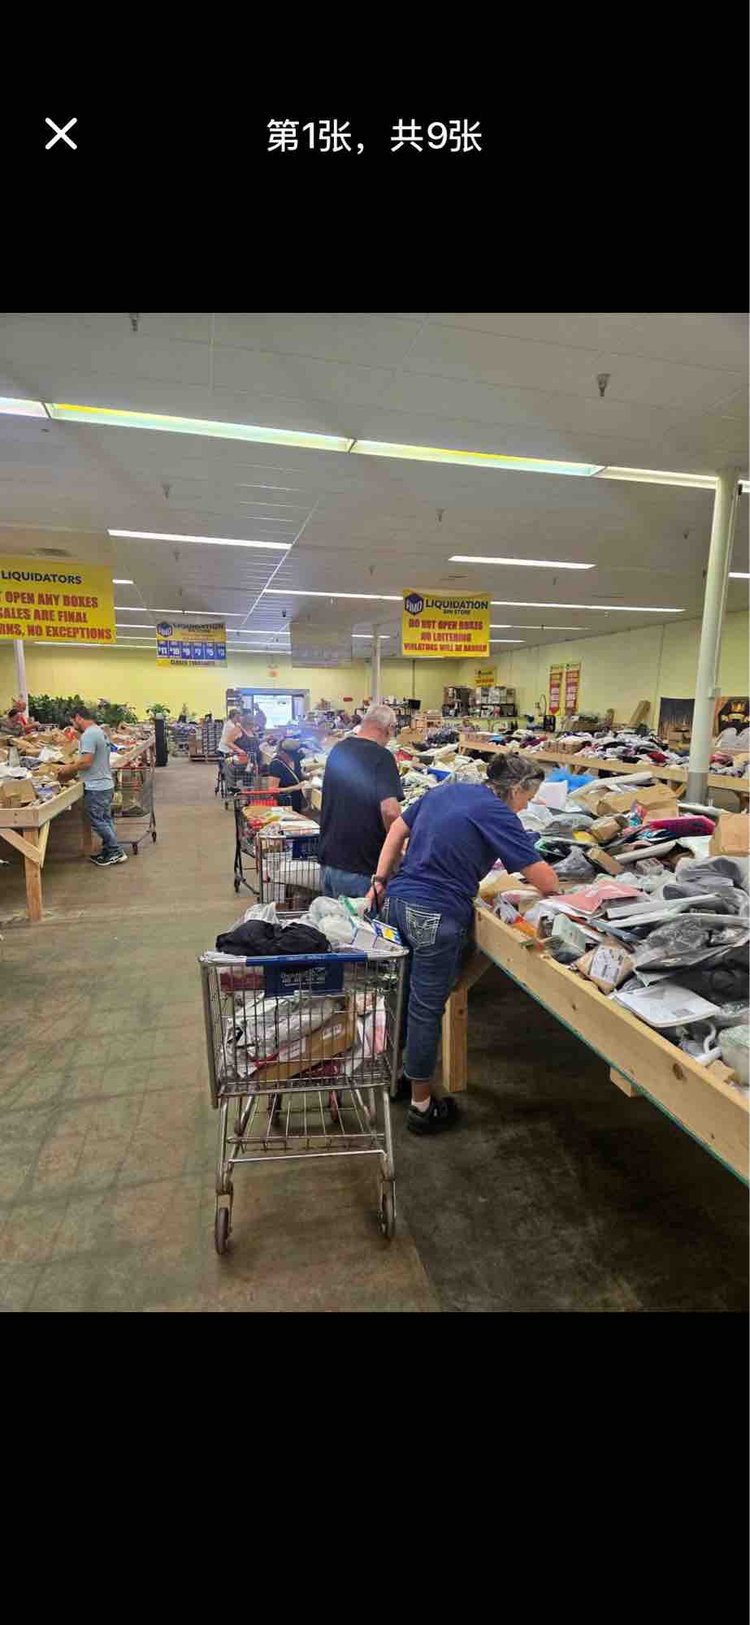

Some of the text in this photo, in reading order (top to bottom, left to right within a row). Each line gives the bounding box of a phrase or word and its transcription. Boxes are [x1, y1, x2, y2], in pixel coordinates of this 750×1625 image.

[1, 570, 83, 584] LIQUIDATORS
[4, 591, 98, 608] OPEN ANY BOXES
[425, 599, 488, 610] LIQUIDATION
[33, 609, 55, 621] ARE
[57, 611, 88, 623] FINAL
[408, 618, 483, 630] DO NOT OPEN BOXES
[27, 624, 43, 636] NO
[46, 626, 112, 640] EXCEPTIONS
[421, 632, 472, 642] NO LOITERING
[403, 643, 438, 651] VIOLATORS
[463, 644, 487, 652] BANNED
